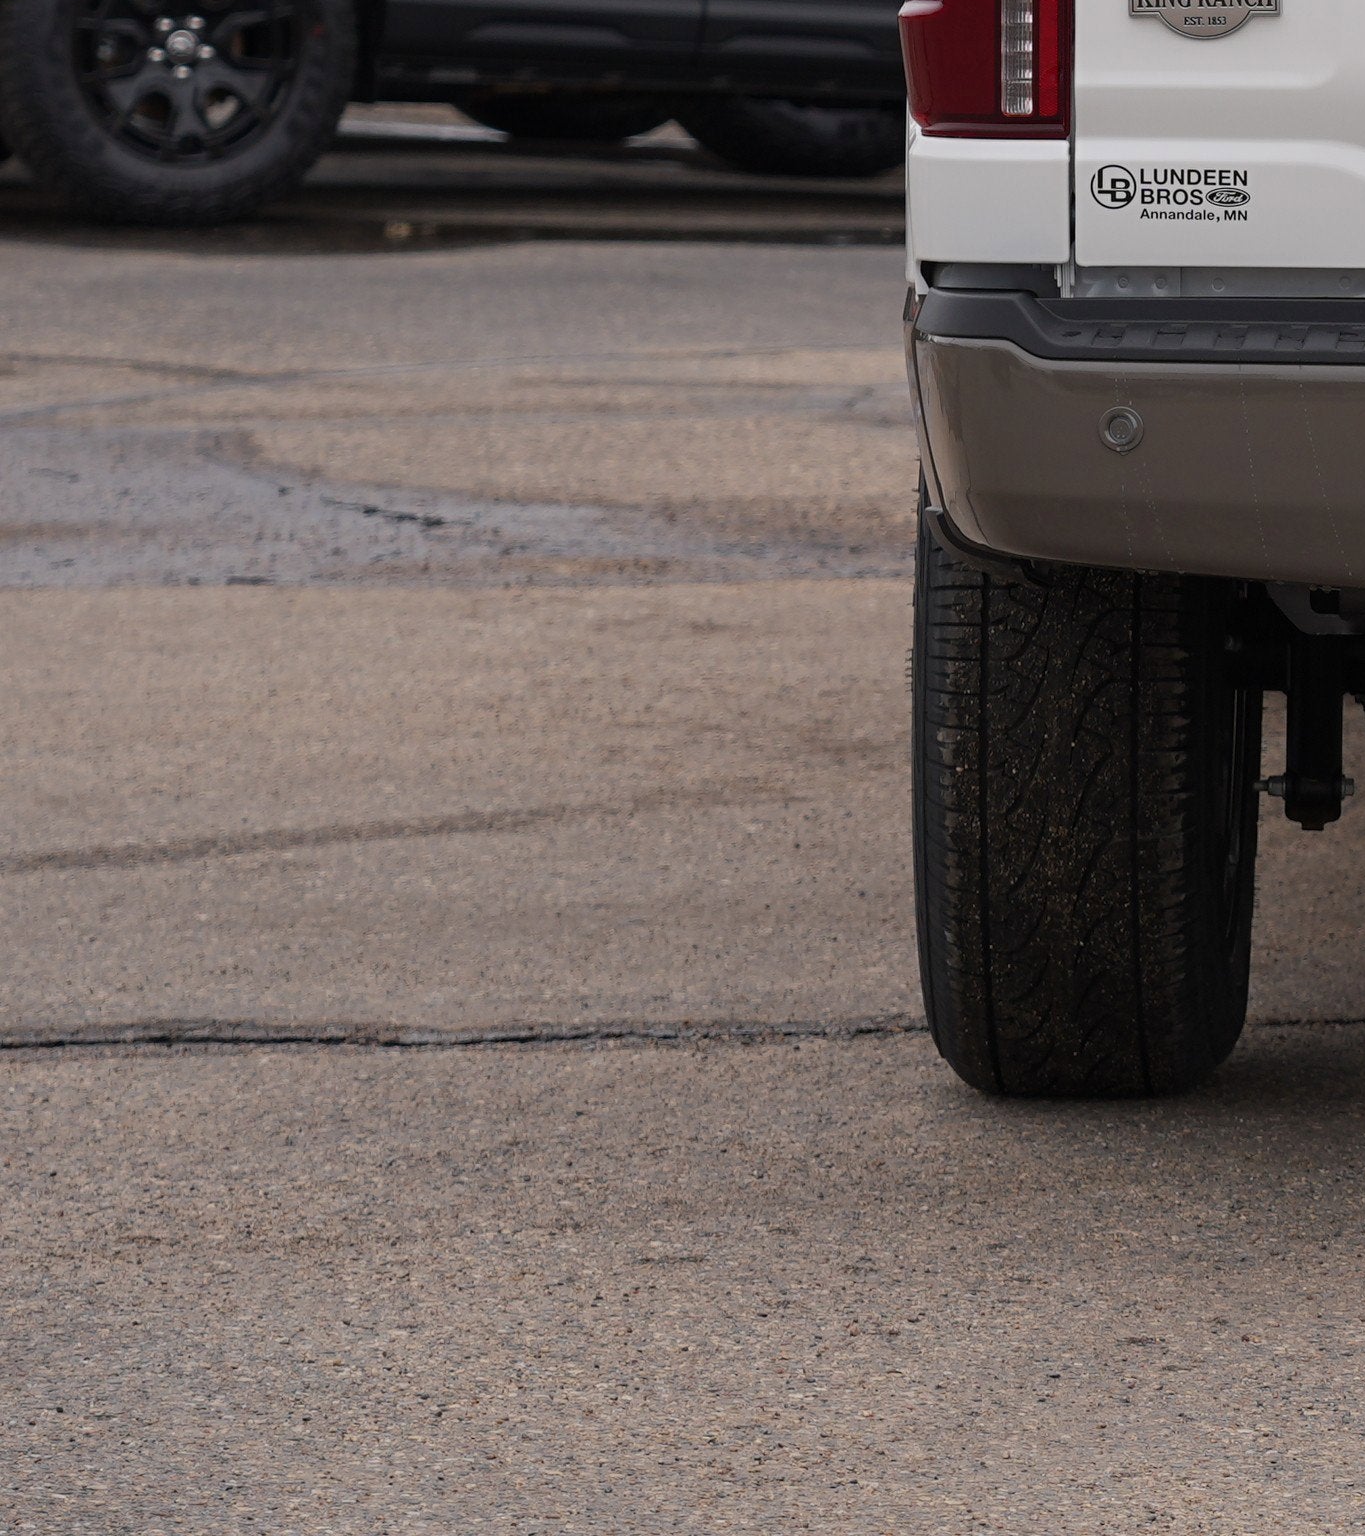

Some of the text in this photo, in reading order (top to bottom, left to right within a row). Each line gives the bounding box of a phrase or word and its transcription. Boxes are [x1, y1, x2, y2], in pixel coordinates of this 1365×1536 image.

[1184, 16, 1227, 26] EST. 1853
[1140, 168, 1248, 186] LUNDEEN
[1140, 188, 1244, 205] BROS Ford
[1140, 208, 1248, 223] Annandale, MN
